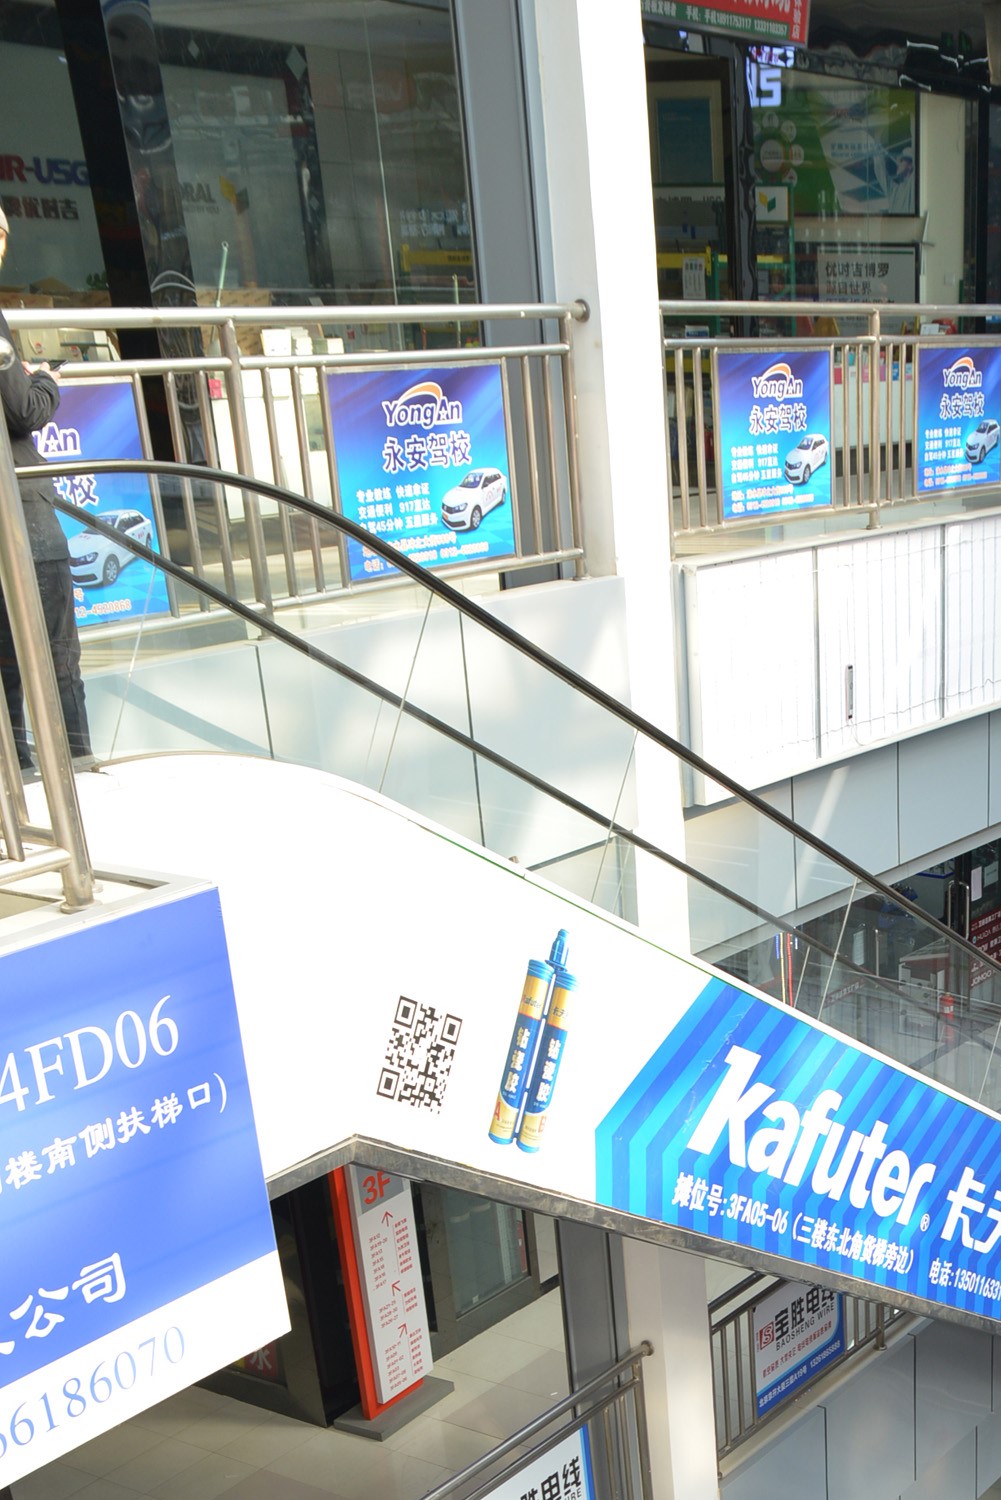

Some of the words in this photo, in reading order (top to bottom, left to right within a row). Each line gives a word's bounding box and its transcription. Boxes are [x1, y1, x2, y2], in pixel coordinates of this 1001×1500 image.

[752, 377, 803, 400] YongAn
[943, 369, 982, 390] YongAn
[382, 397, 462, 428] YongAn
[750, 403, 807, 434] 永安驾校
[940, 392, 985, 420] 永安驾校
[382, 431, 472, 473] 永安驾校
[0, 995, 179, 1112] 4FD06
[0, 1072, 227, 1190] 楼南侧扶梯口)
[362, 1171, 391, 1206] 3F
[672, 1171, 789, 1235] 摊位号:3FA05-06
[792, 1212, 914, 1275] (三楼东北角货梯旁边)
[0, 1252, 127, 1355] 公司
[774, 1287, 835, 1341] 宝胜电线
[776, 1316, 815, 1352] BAOSHENG
[817, 1302, 835, 1320] WIRE
